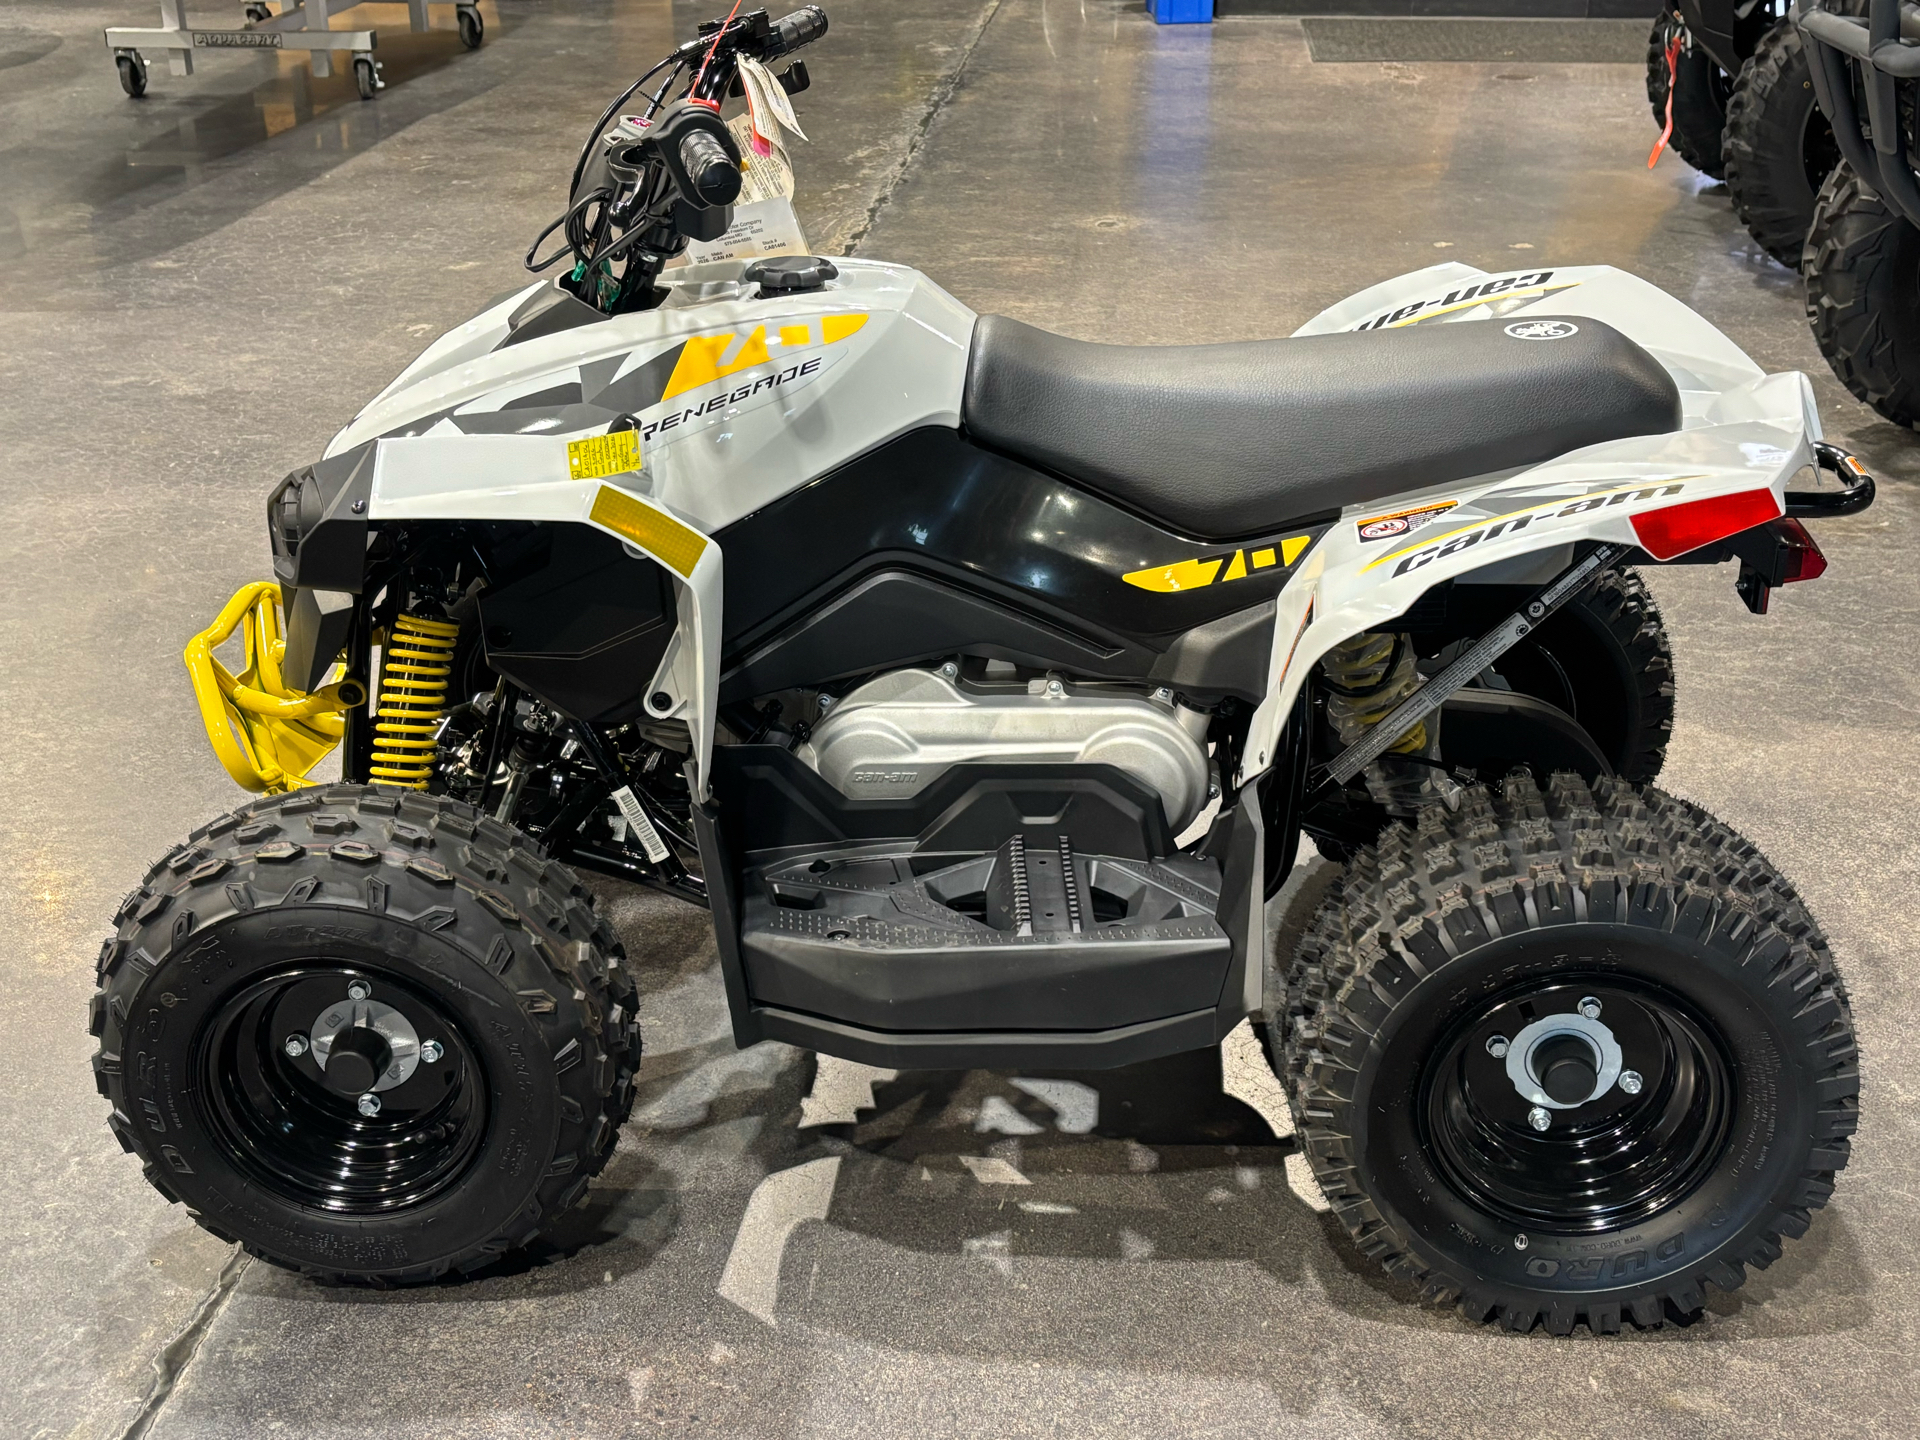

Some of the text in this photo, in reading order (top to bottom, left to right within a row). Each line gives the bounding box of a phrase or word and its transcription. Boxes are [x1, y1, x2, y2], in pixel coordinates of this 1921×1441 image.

[739, 218, 762, 228] Company
[713, 254, 725, 262] CAN
[641, 356, 822, 442] RENEGADE
[1389, 505, 1434, 518] WARNING
[1391, 483, 1685, 579] can-am
[852, 771, 918, 783] can-am
[1524, 1231, 1685, 1281] DURO
